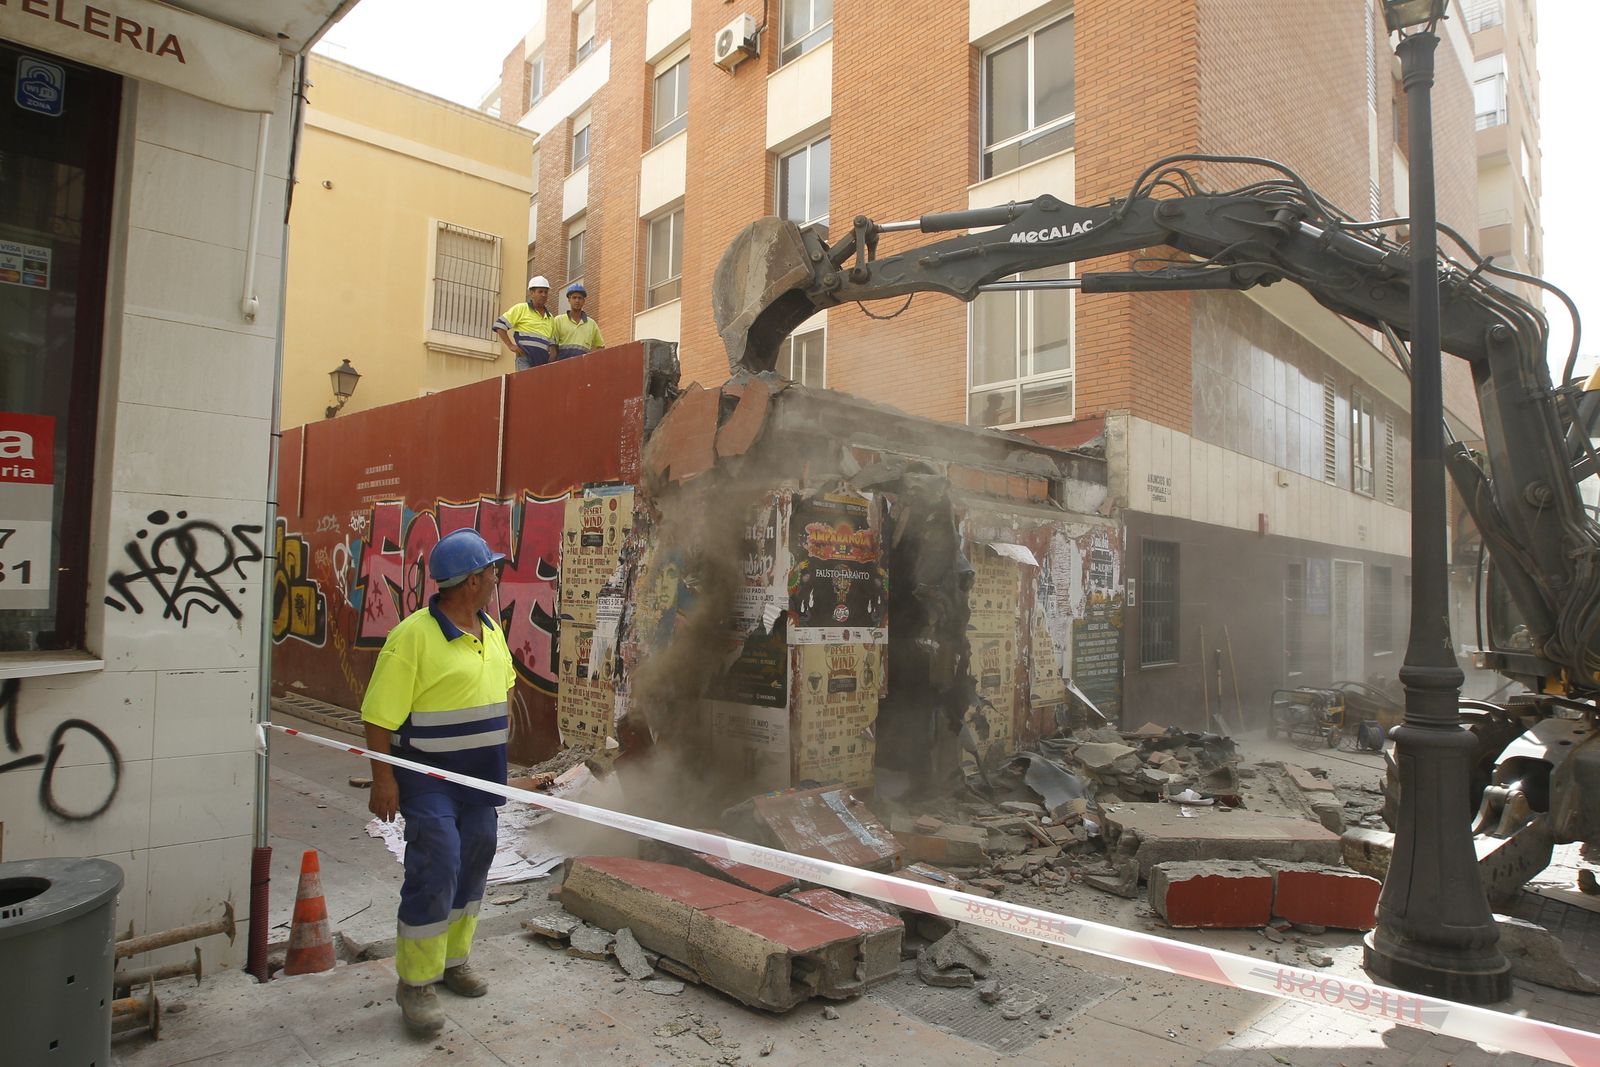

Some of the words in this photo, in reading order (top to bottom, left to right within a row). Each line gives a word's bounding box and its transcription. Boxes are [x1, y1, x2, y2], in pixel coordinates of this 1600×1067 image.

[0, 0, 186, 64] ELERIA
[26, 98, 52, 110] ZONA
[583, 507, 602, 515] DESERT
[583, 515, 602, 527] WIND
[816, 568, 839, 578] FAUSTO
[830, 646, 854, 654] DESERT
[831, 656, 854, 669] WIND
